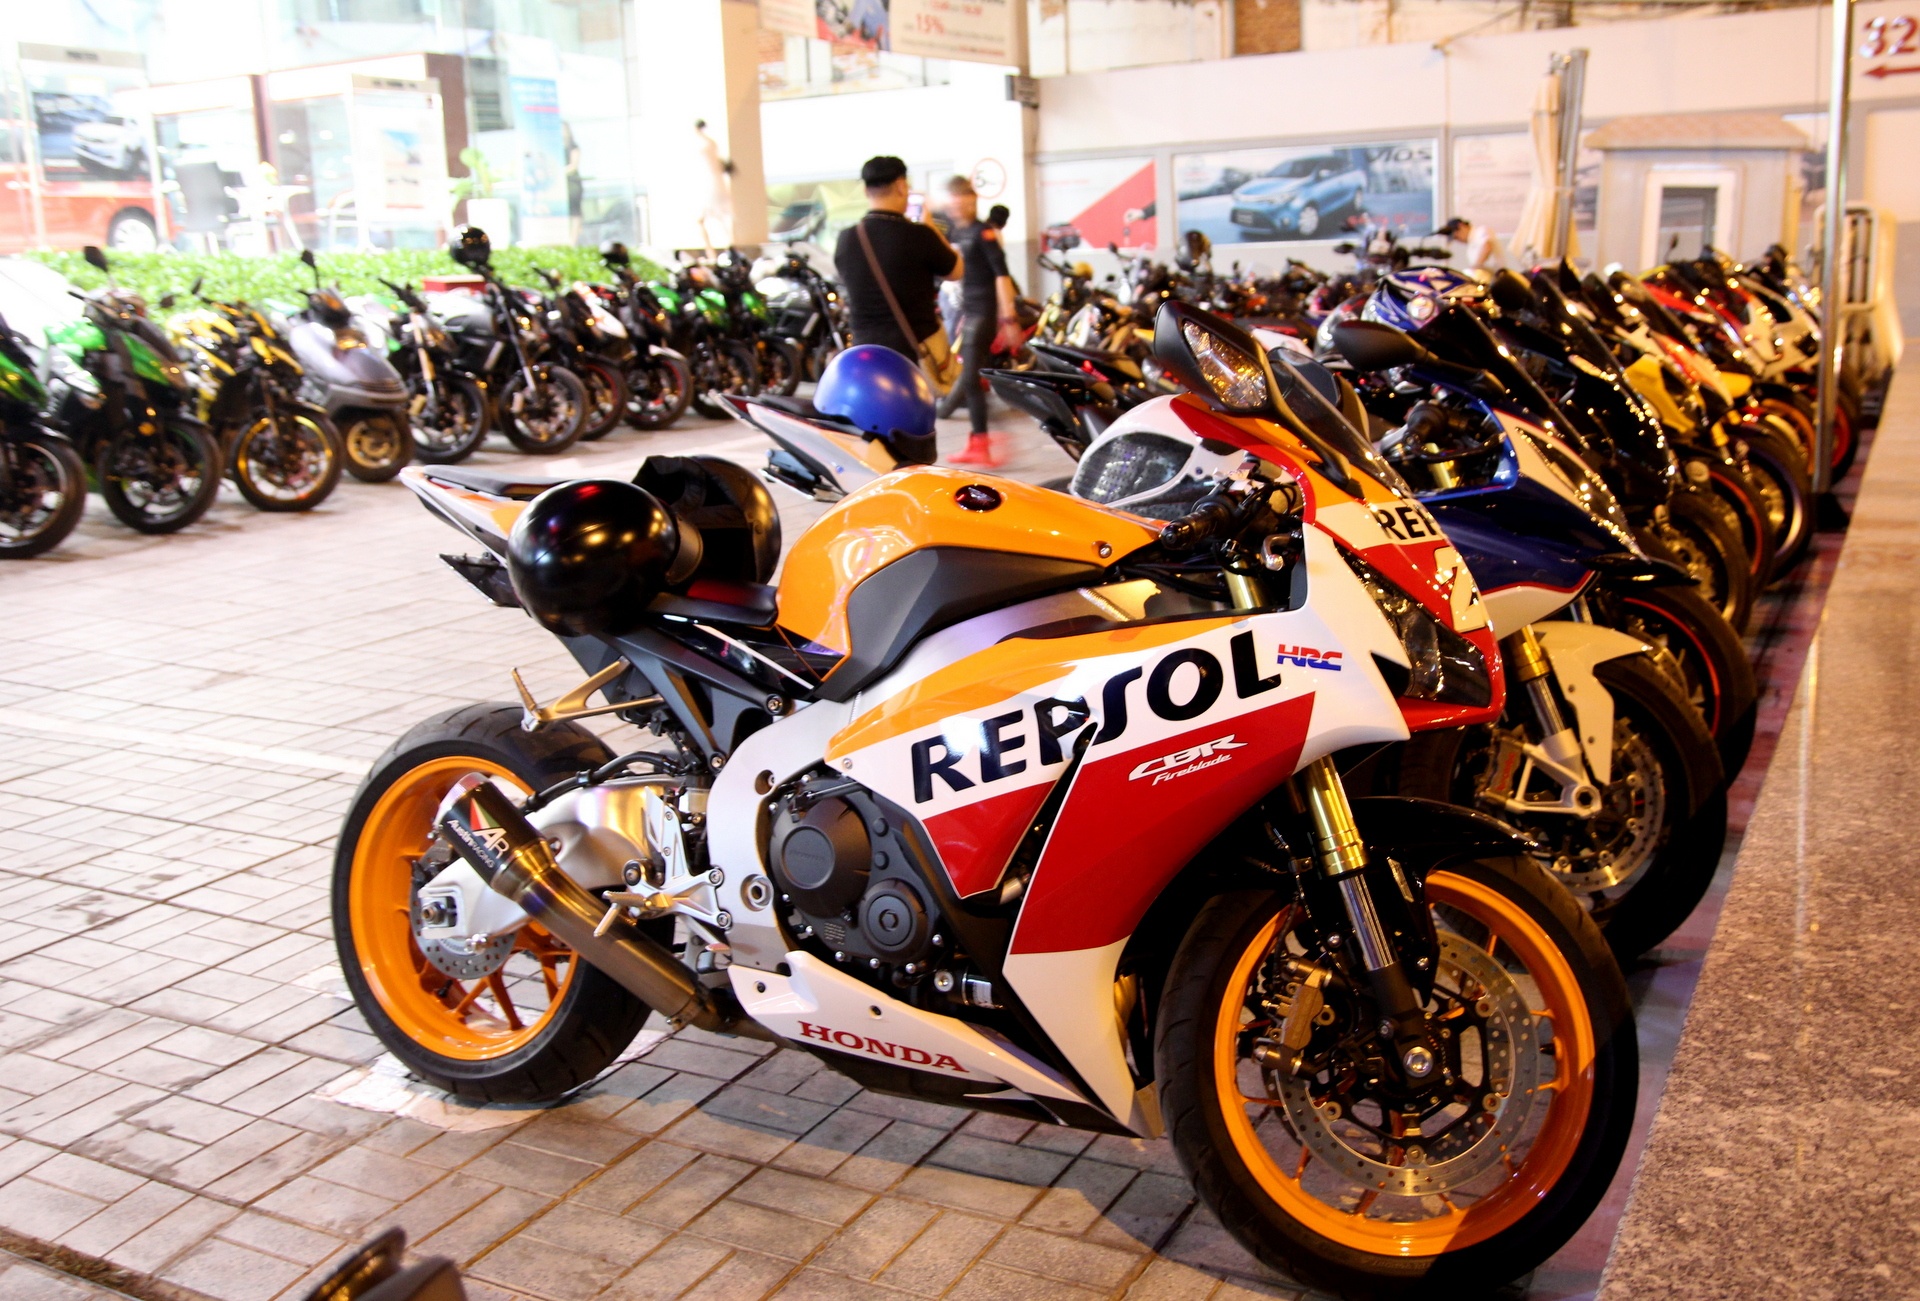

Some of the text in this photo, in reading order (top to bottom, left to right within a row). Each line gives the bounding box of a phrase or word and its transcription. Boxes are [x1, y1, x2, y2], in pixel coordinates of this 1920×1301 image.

[1277, 644, 1343, 671] HRC
[911, 630, 1282, 803] REPSOL
[1128, 734, 1249, 782] CBR
[1151, 753, 1233, 787] Fireblade
[472, 827, 510, 859] AR
[798, 1020, 971, 1073] HONDA
